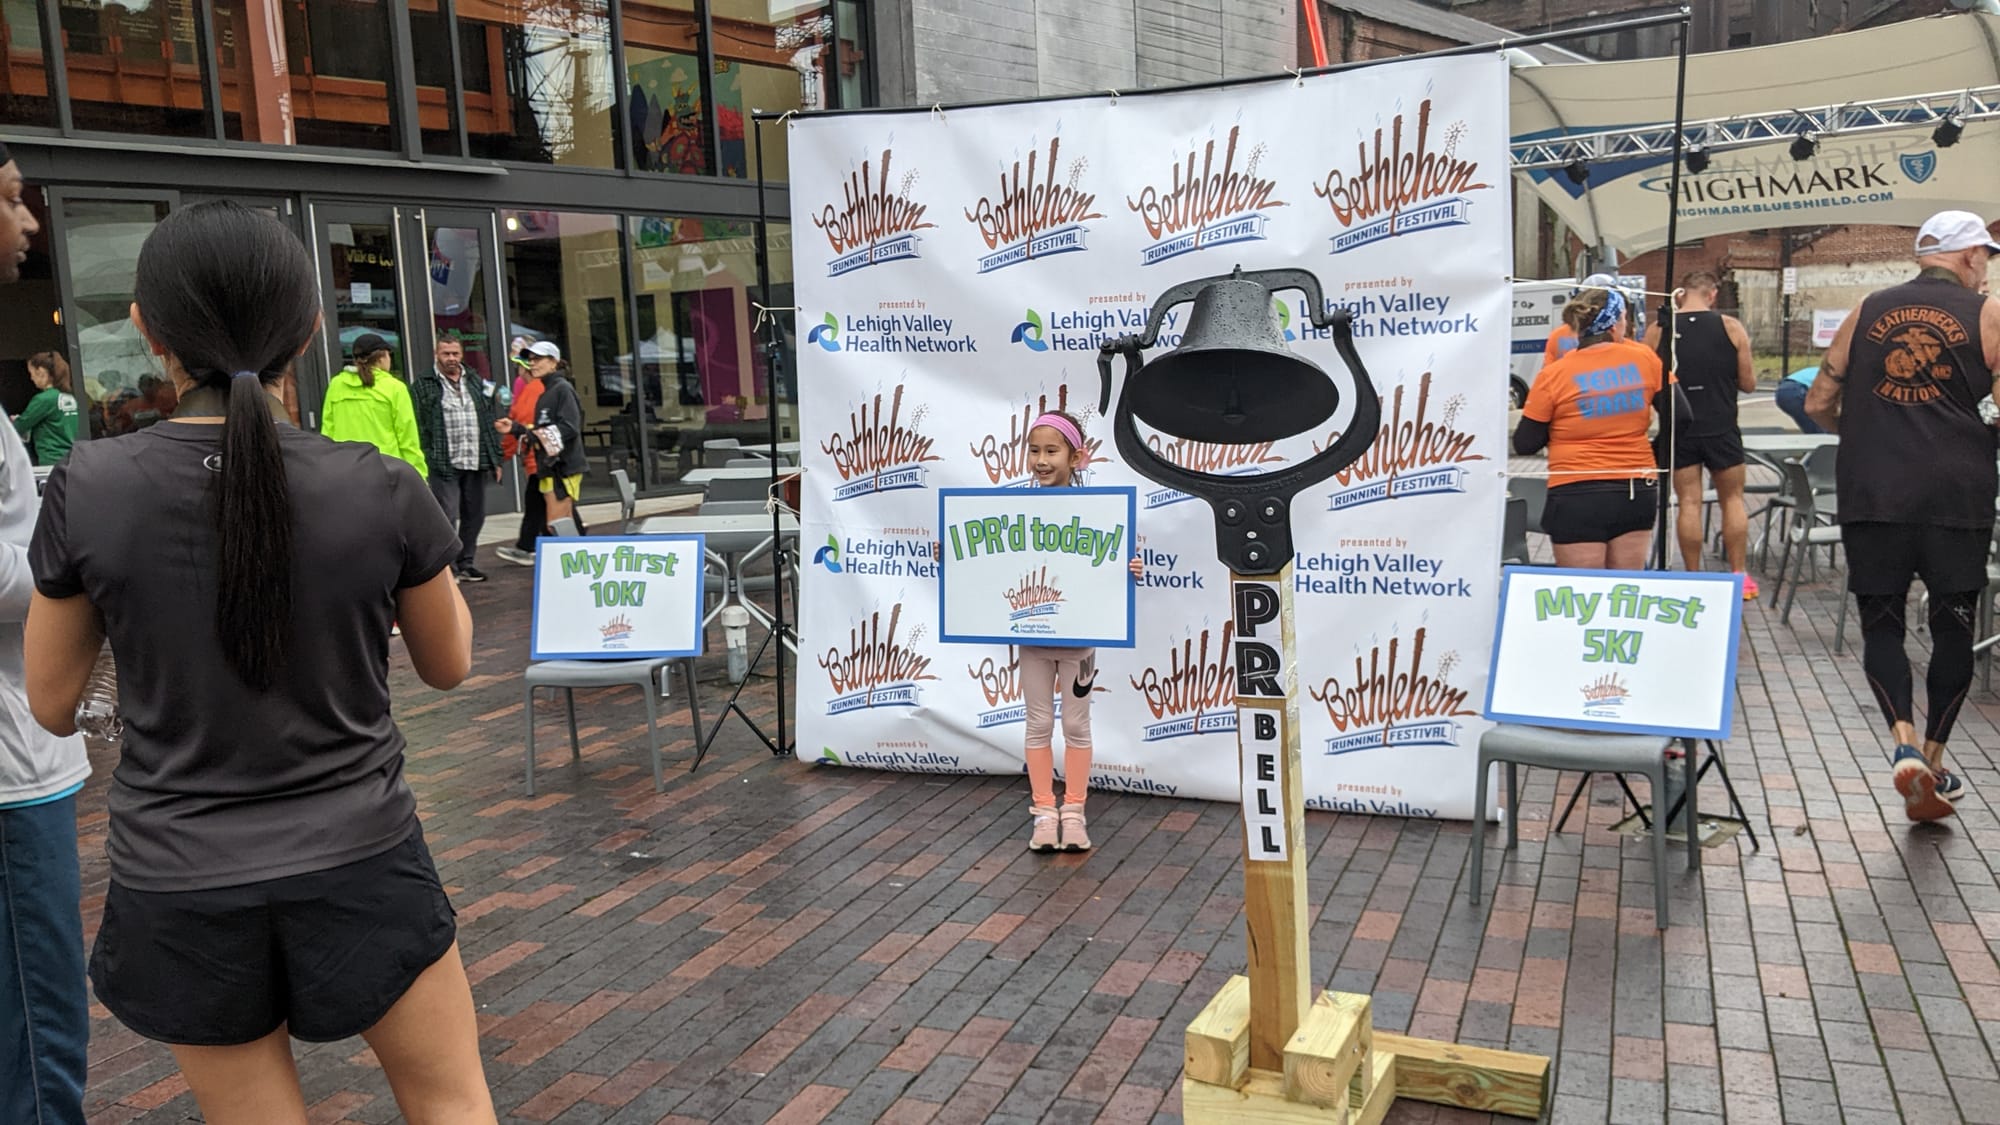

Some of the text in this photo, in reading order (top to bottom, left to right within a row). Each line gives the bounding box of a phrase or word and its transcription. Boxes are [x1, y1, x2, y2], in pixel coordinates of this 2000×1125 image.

[1313, 99, 1494, 228] Bethlehem
[964, 137, 1107, 250] Bethlehem
[1127, 126, 1290, 240] Bethlehem
[812, 149, 938, 255] Bethlehem
[1147, 221, 1256, 260] RUNNING FESTIVAL
[1337, 206, 1457, 249] RUNNING FESTIVAL
[832, 240, 912, 274] RUNNING FESTIVAL
[983, 231, 1078, 270] RUNNING FESTIVAL
[1344, 277, 1413, 291] presented by
[878, 299, 926, 310] presented by
[1089, 292, 1146, 304] presented by
[1379, 293, 1450, 315] Valley
[846, 314, 953, 336] Lehigh Valley
[1051, 309, 1115, 332] Lehigh
[1301, 313, 1478, 340] Heth Network
[1870, 308, 1965, 342] LEATHERNECKS
[845, 335, 978, 352] Health Network
[1574, 363, 1644, 393] TEAM
[1880, 382, 1941, 401] NATION
[820, 384, 944, 481] Bethlehem
[838, 471, 919, 497] RUNNING FESTIVAL
[1335, 474, 1453, 506] RUNNING FESTIVAL
[883, 527, 930, 537] presented by
[949, 514, 1124, 567] I PR'd today!
[1137, 533, 1147, 544] by
[1340, 537, 1408, 548] presented by
[846, 538, 905, 559] Lehigh
[560, 545, 679, 579] My first
[846, 557, 901, 576] Health
[1296, 552, 1443, 577] Lehigh Valley
[589, 581, 647, 608] 10K!
[1002, 566, 1067, 611] Bethlehem
[1295, 575, 1471, 597] Health Network
[1535, 584, 1705, 629] My first
[817, 603, 942, 695] Bethlehem
[1583, 629, 1643, 664] 5K!
[1129, 620, 1238, 720] Bethleh
[1309, 627, 1483, 732] Bethlehem
[831, 689, 913, 711] RUNNING FESTIVAL
[983, 709, 1026, 725] RUNNING
[1149, 721, 1193, 737] RUNNING
[919, 741, 928, 749] by
[1332, 725, 1446, 751] RUNNING FESTIVAL
[845, 751, 959, 767] Lehigh Valley
[1118, 775, 1177, 795] Valley
[1254, 713, 1281, 852] BELL
[1337, 783, 1402, 796] presented by
